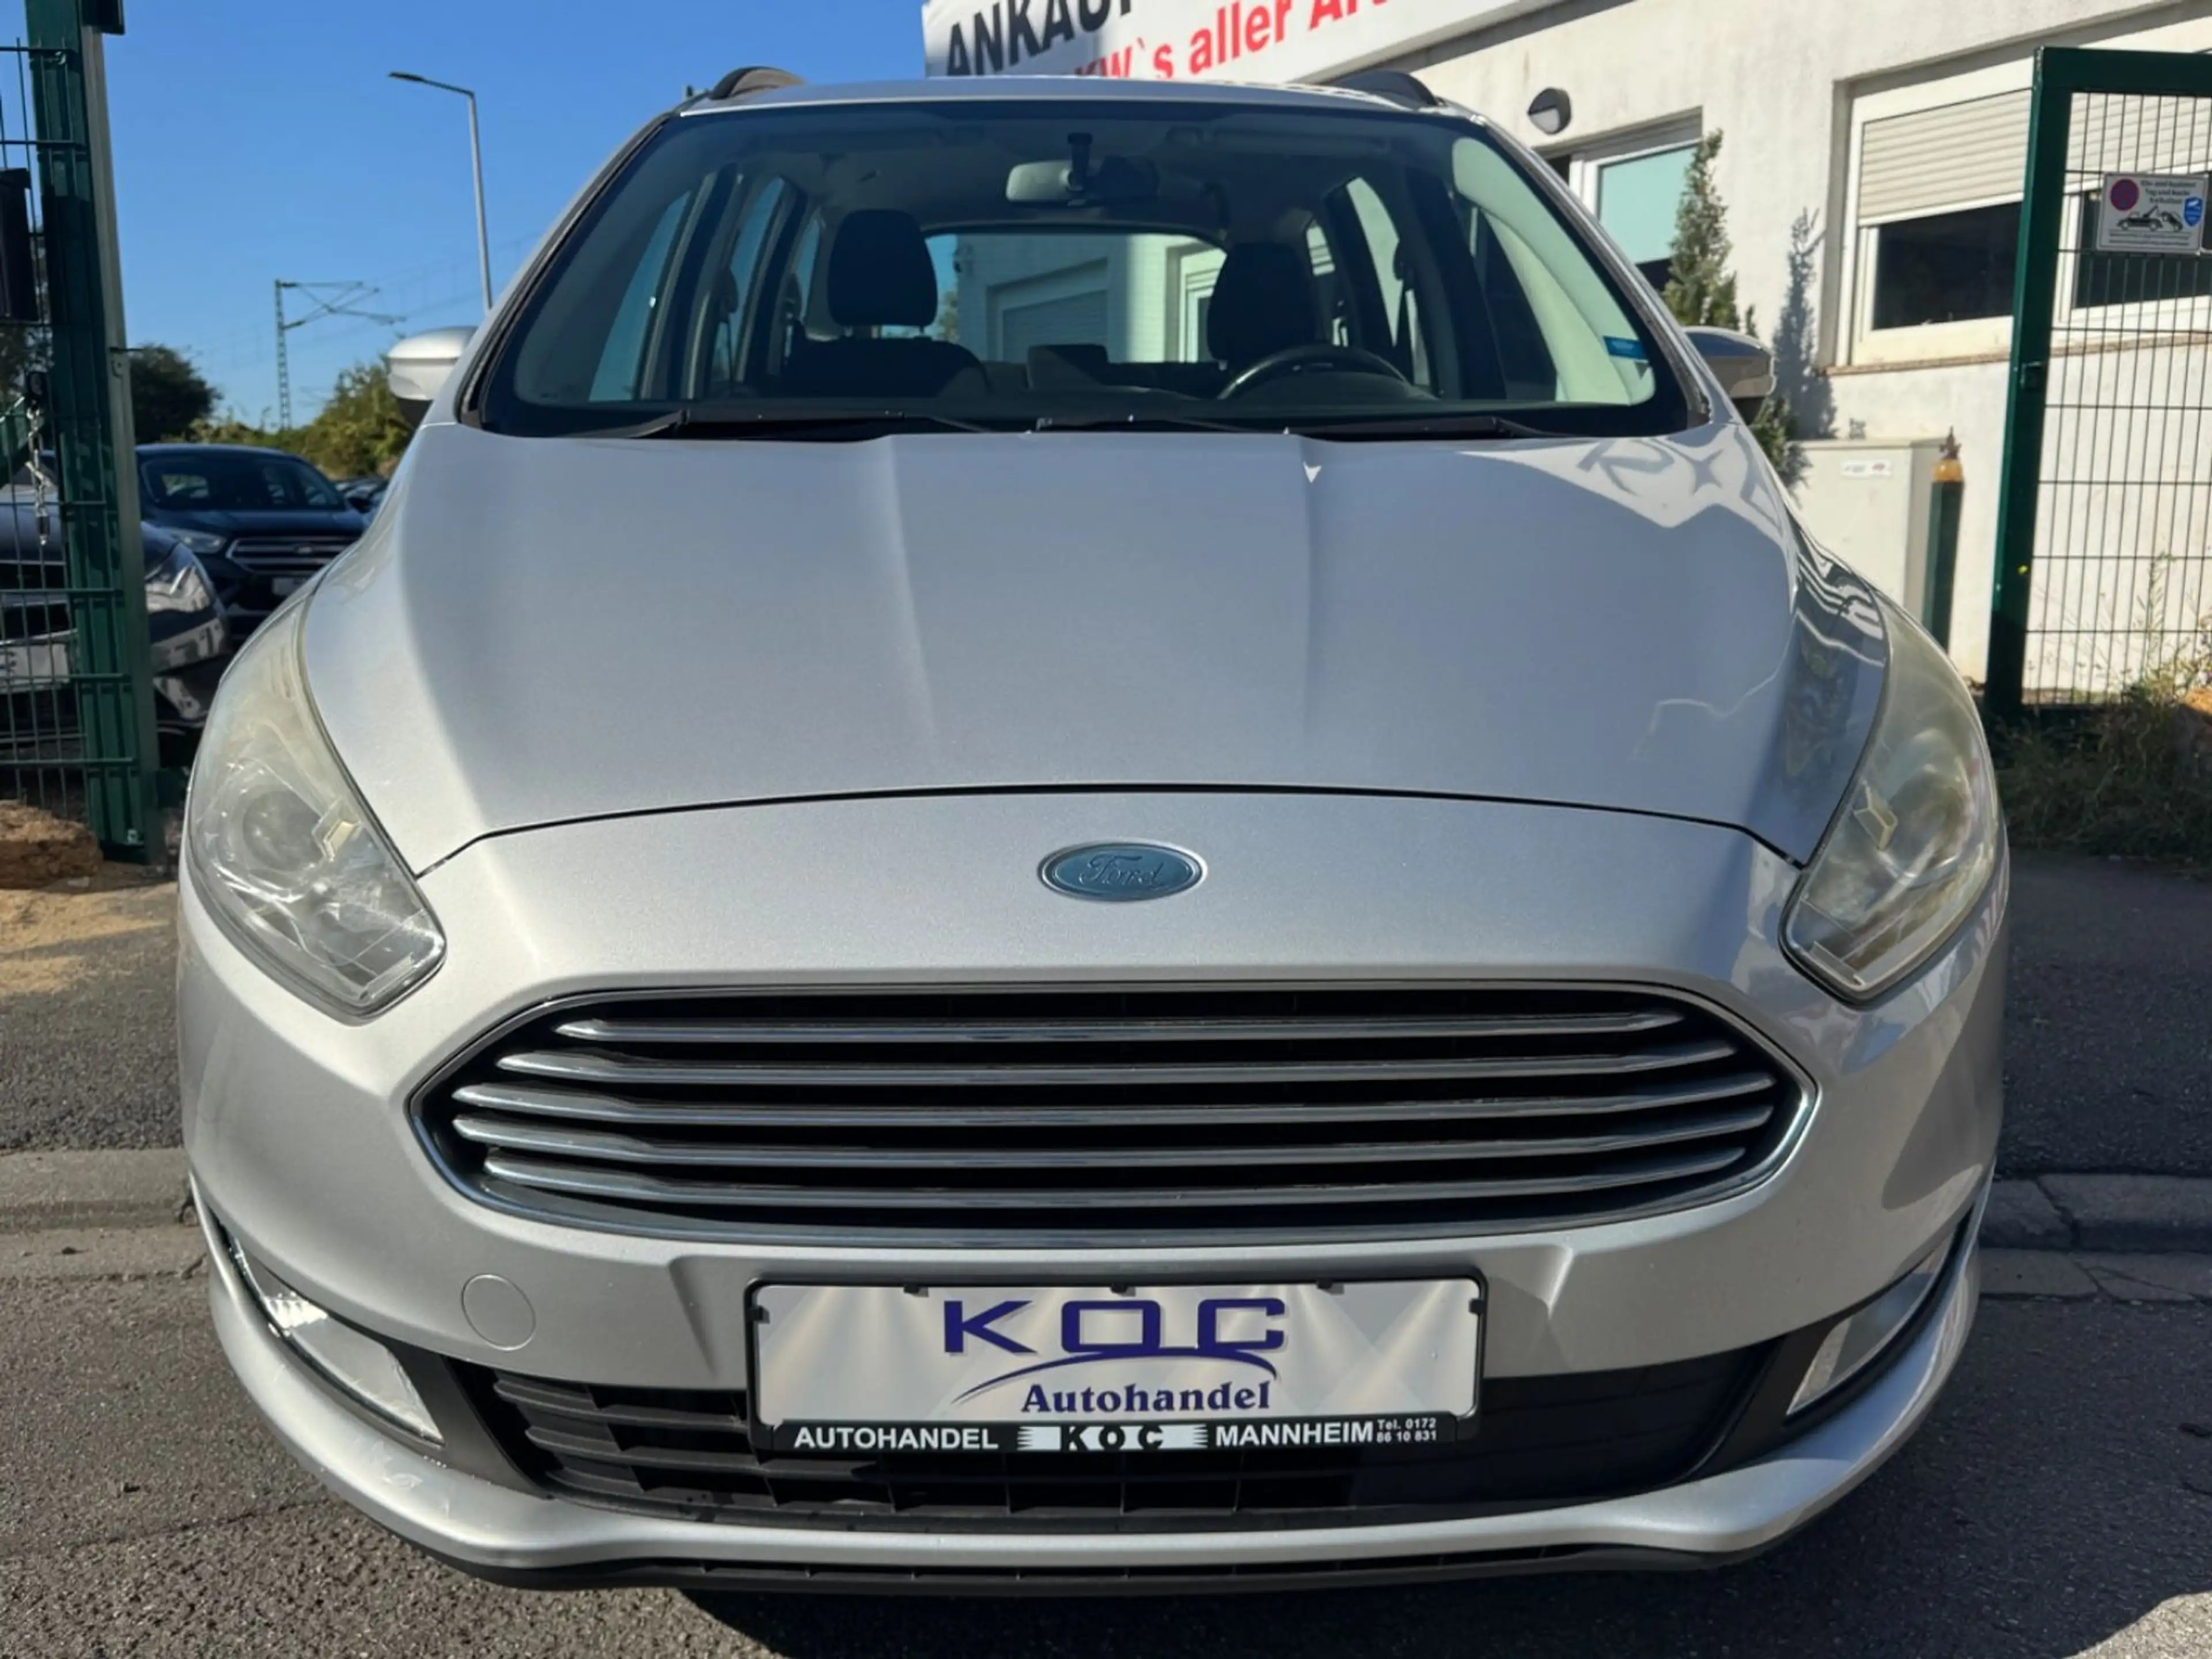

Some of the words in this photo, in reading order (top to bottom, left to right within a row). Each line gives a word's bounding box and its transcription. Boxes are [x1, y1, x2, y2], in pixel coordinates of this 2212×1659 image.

[947, 0, 1132, 75] ANKAU
[1189, 0, 1292, 74] aller
[1077, 853, 1167, 887] Ford
[945, 1298, 1285, 1353] KOC
[1021, 1381, 1270, 1412] Autohandel
[794, 1427, 999, 1449] AUTOHANDEL
[1060, 1425, 1164, 1450] KOC
[1215, 1422, 1373, 1447] MANNHEIM
[1377, 1419, 1401, 1430] Tel.
[1406, 1417, 1436, 1429] 0172
[1396, 1431, 1411, 1442] 10
